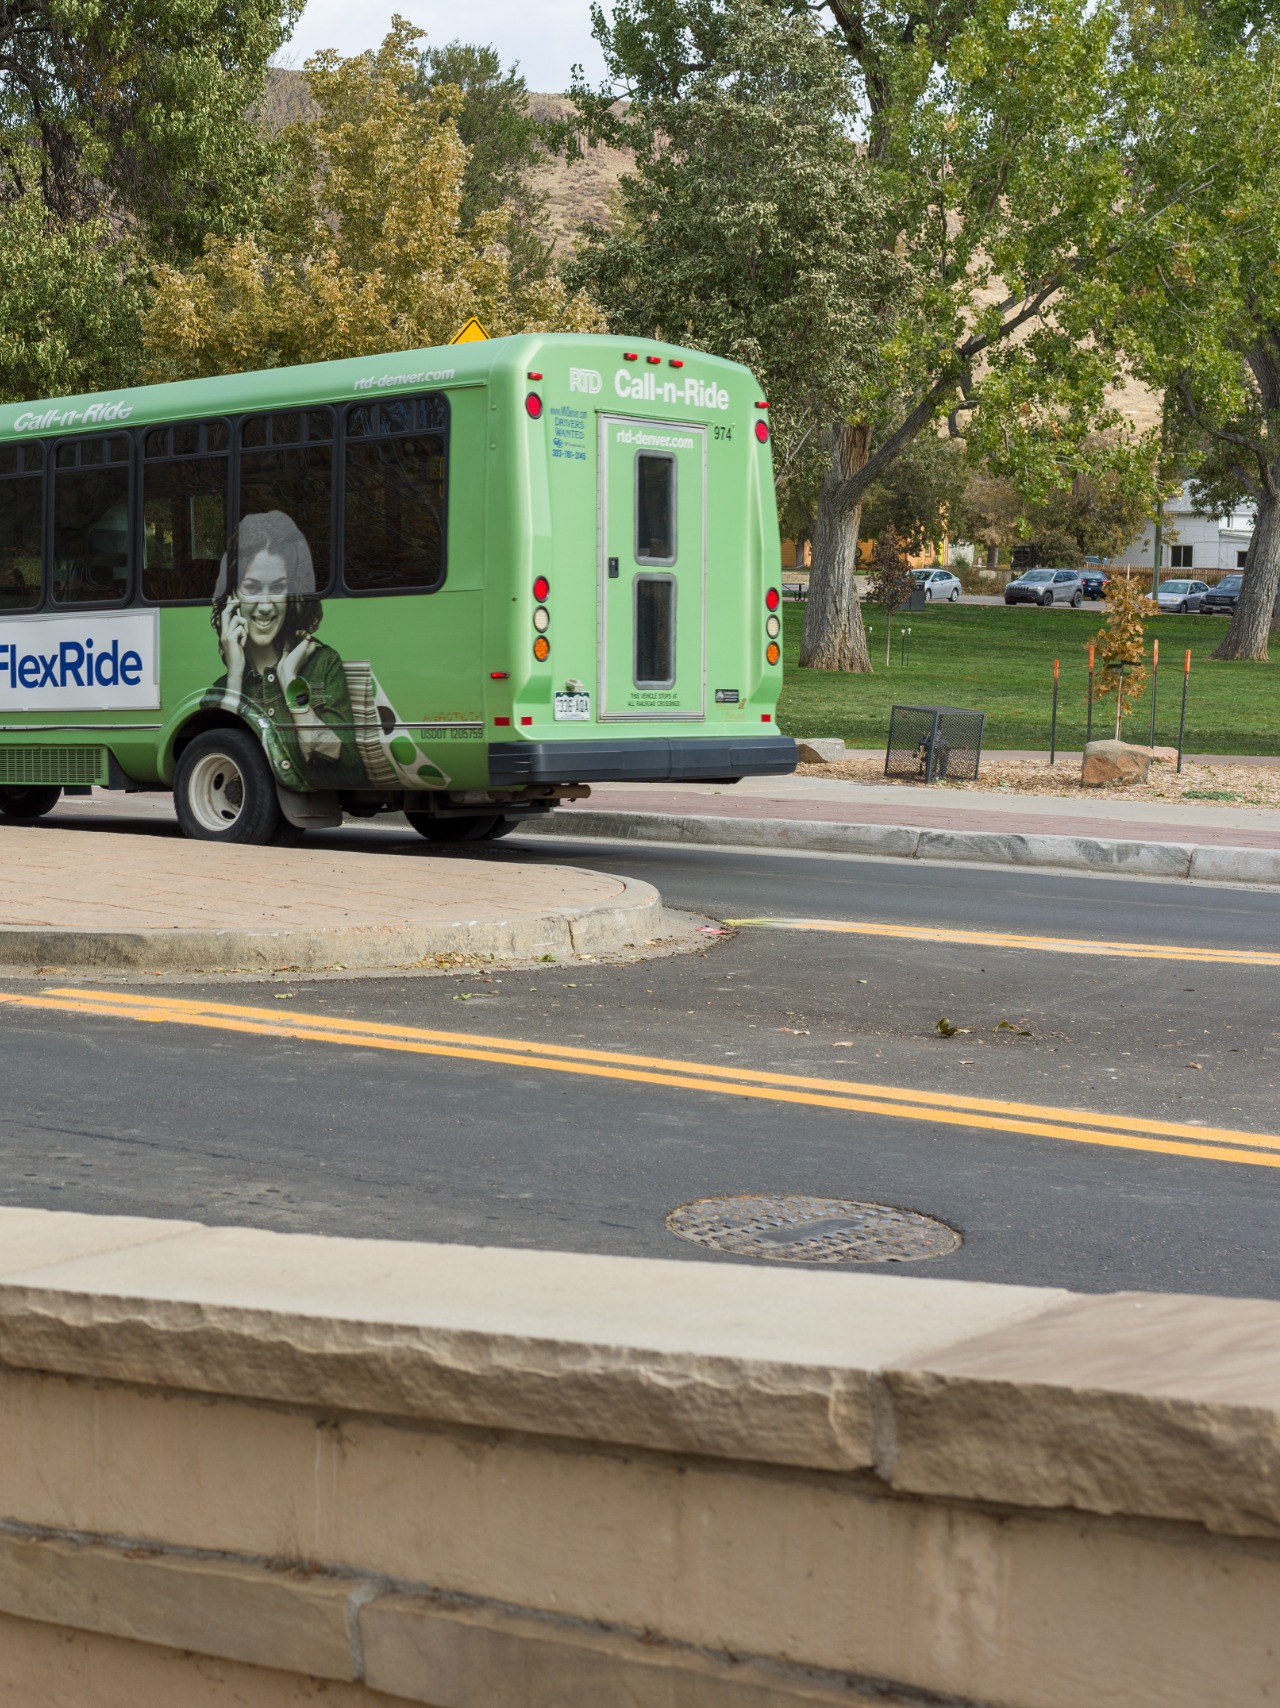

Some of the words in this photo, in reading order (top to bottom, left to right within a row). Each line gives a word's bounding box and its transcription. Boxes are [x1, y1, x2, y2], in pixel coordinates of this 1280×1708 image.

[354, 369, 455, 390] rtd-denver.com
[569, 368, 602, 393] RTD
[615, 369, 729, 410] Call-n-Ride
[13, 401, 133, 432] Call-n-Ride
[554, 417, 585, 429] DRIVERS
[617, 429, 694, 449] rtd-denver.com
[713, 426, 732, 441] 974
